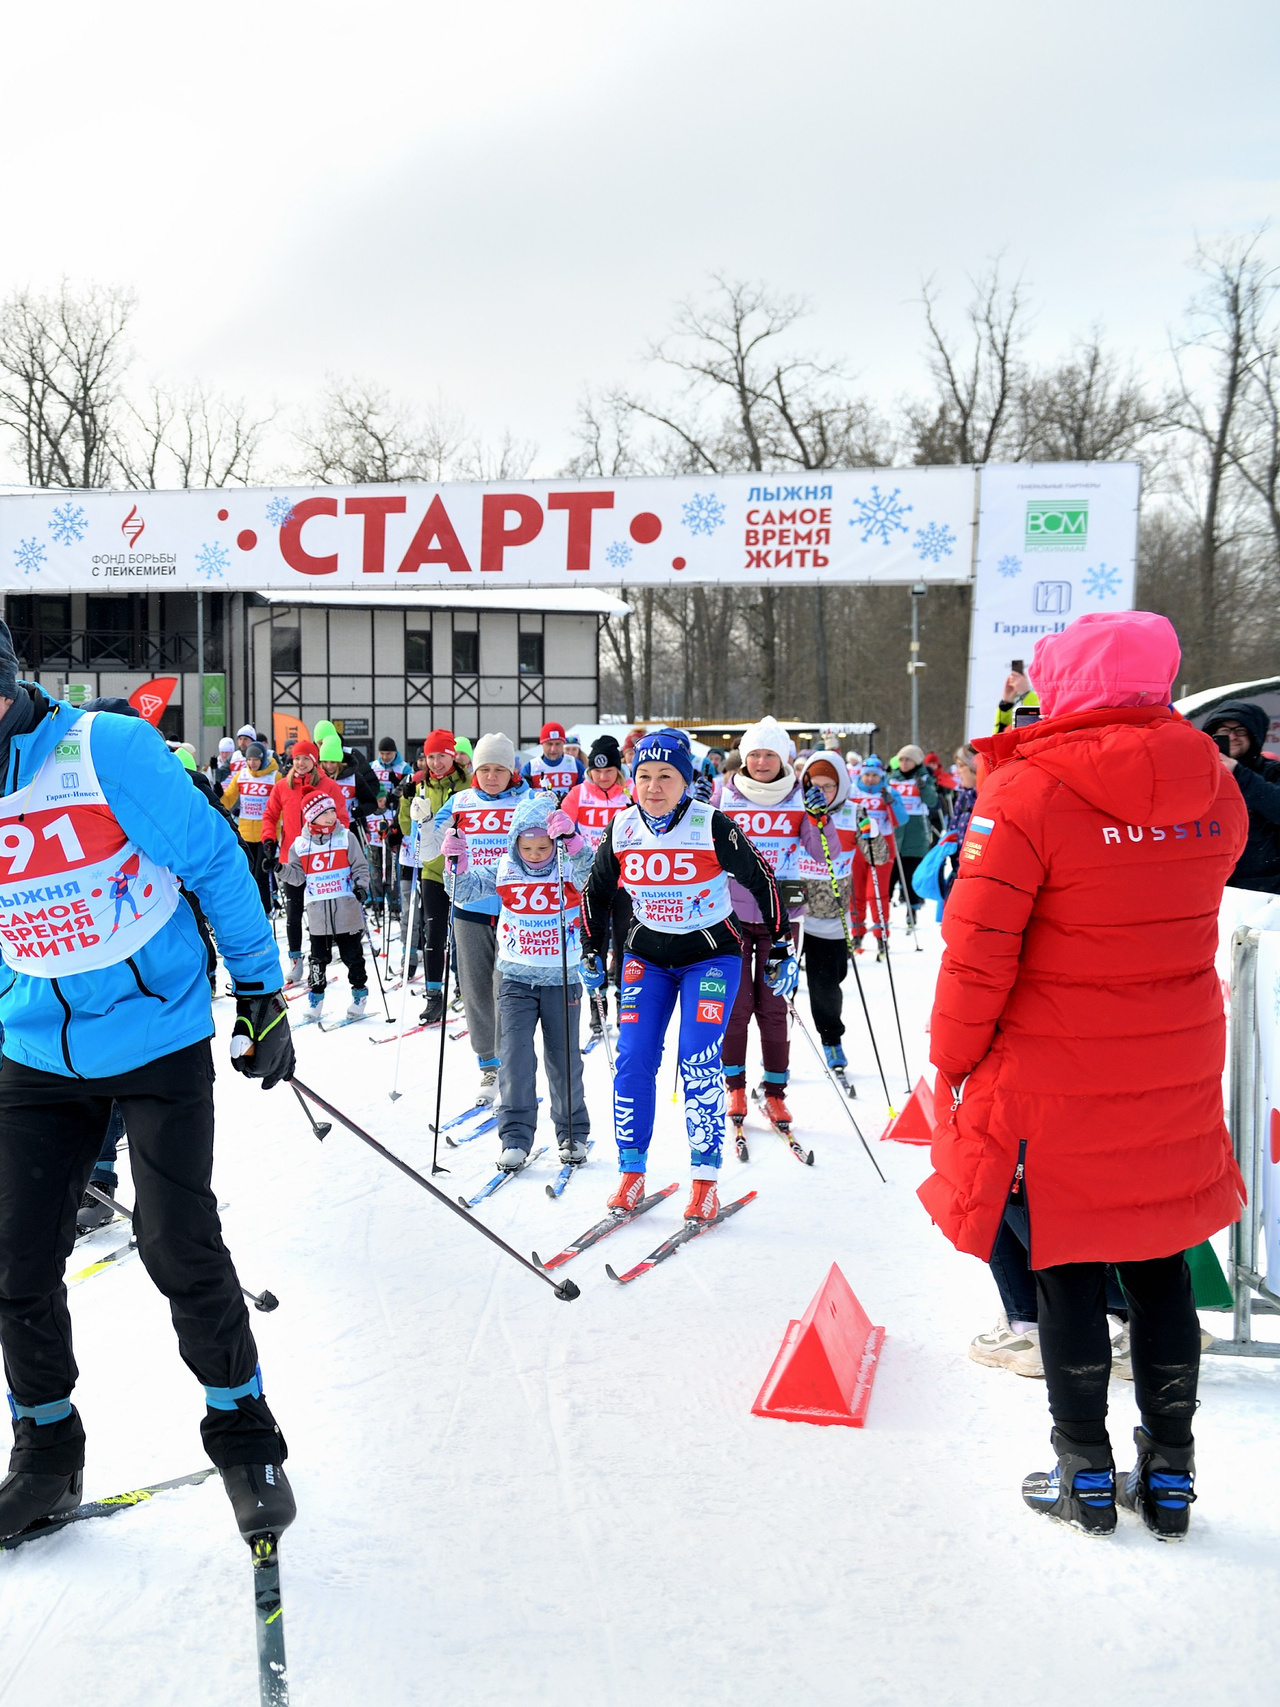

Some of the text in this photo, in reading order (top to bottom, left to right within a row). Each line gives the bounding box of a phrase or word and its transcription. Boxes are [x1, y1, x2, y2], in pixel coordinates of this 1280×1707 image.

[747, 485, 834, 503] ЛЫЖНЯ
[745, 507, 833, 526] САМОЕ
[279, 491, 615, 575] СТАРТ
[744, 527, 832, 547] ВРЕМЯ
[91, 552, 177, 565] ФОНД БОРЬБЫ
[743, 548, 830, 569] ЖИТЬ
[91, 563, 177, 577] С ЛЕЙКЕМИЕЙ
[638, 748, 672, 762] RWT
[45, 790, 100, 802] Гарант-Инвест
[241, 782, 268, 796] 126
[896, 784, 914, 796] 91
[464, 811, 512, 832] 365
[733, 812, 792, 835] 804
[1101, 819, 1221, 845] RUSSIA
[471, 837, 508, 846] ЛЫЖНЯ
[311, 851, 336, 872] 67
[624, 852, 698, 882] 805
[797, 857, 827, 865] САМО
[315, 873, 340, 882] ЛЫЖНЯ
[316, 880, 341, 889] САМОЕ
[316, 886, 343, 895] ВРЕМЯ
[640, 890, 683, 899] ЛЫЖНЯ
[510, 885, 568, 911] 363
[645, 904, 684, 914] ВРЕМЯ
[519, 917, 558, 928] ЛЫЖНЯ
[644, 913, 684, 923] ЖИТЬ
[0, 913, 95, 941] ВРЕМЯ
[519, 929, 560, 938] САМОЕ
[15, 933, 101, 959] ЖИТЬ
[519, 936, 560, 946] ВРЕМЯ
[519, 945, 560, 956] ЖИТЬ
[614, 1090, 634, 1142] RWT
[1021, 1478, 1061, 1488] SPINE
